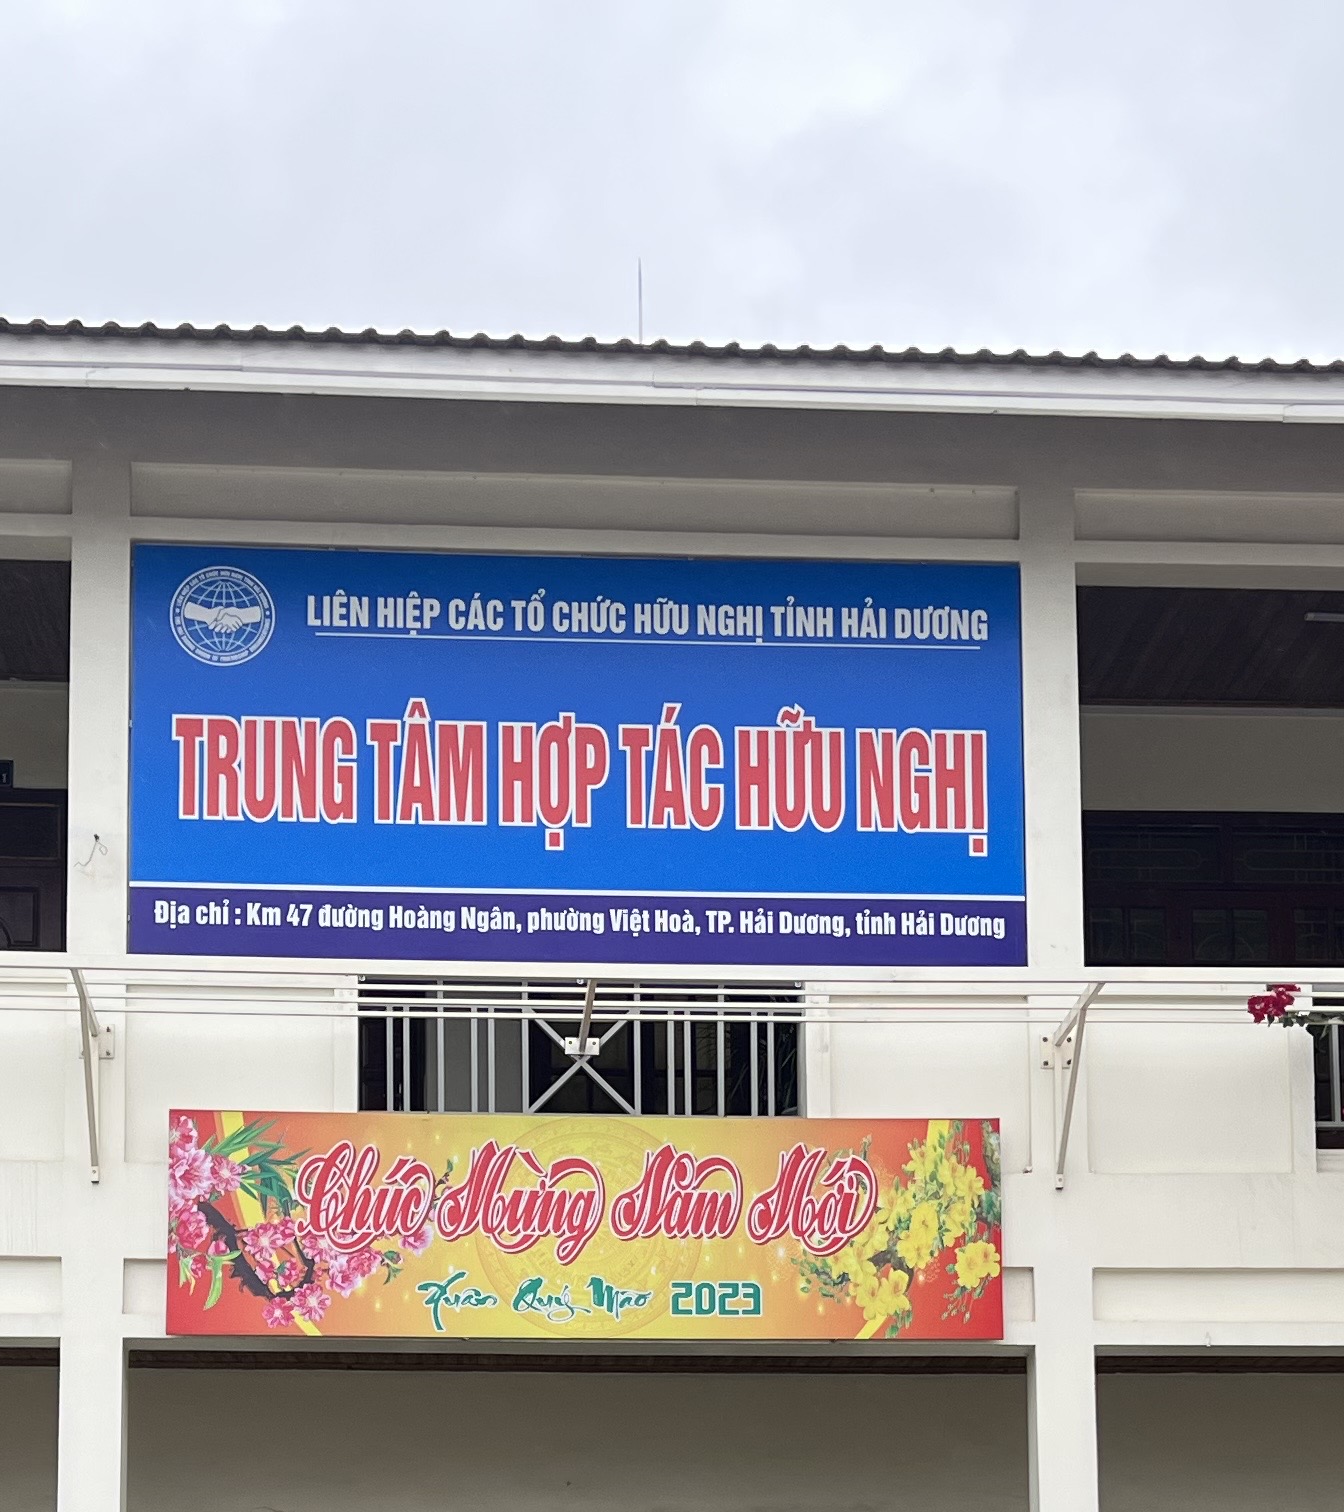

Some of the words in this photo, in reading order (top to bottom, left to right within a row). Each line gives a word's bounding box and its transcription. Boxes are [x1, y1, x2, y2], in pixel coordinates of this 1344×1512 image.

[308, 589, 368, 627] LIÊN
[377, 592, 441, 636] HIỆP
[449, 593, 503, 630] CÁC
[511, 589, 545, 631] TỔ
[553, 596, 626, 633] CHỨC
[635, 598, 688, 634] HỮU
[697, 605, 763, 644] NGHỊ
[771, 596, 833, 637] TỈNH
[842, 597, 886, 638] HẢI
[895, 606, 987, 640] DƯƠNG
[172, 714, 357, 824] TRUNG
[366, 698, 487, 825] TÂM
[498, 712, 610, 850] HỢP
[618, 702, 724, 831] TÁC
[735, 703, 845, 832] HỮU
[856, 728, 988, 857] NGHỊ
[154, 901, 189, 928] Địa
[196, 899, 229, 924] chỉ
[247, 903, 281, 925] Km
[287, 904, 313, 926] 47
[319, 904, 383, 930] đường
[389, 906, 455, 932] Hoàng
[461, 906, 521, 933] Ngân,
[528, 908, 604, 934] phường
[610, 909, 650, 936] Việt
[655, 910, 700, 935] Hoà,
[706, 911, 734, 933] TP.
[740, 908, 772, 933] Hải
[779, 912, 850, 937] Dương,
[856, 909, 895, 935] tỉnh
[901, 910, 934, 935] Hải
[941, 913, 1005, 939] Dương
[295, 1140, 434, 1253] Chúc
[437, 1139, 605, 1265] Mừng
[610, 1142, 743, 1240] Năm
[746, 1142, 878, 1257] Mới
[417, 1271, 497, 1331] Xuân
[512, 1276, 592, 1322] Quý
[586, 1276, 653, 1321] Mão
[670, 1281, 762, 1317] 2023
